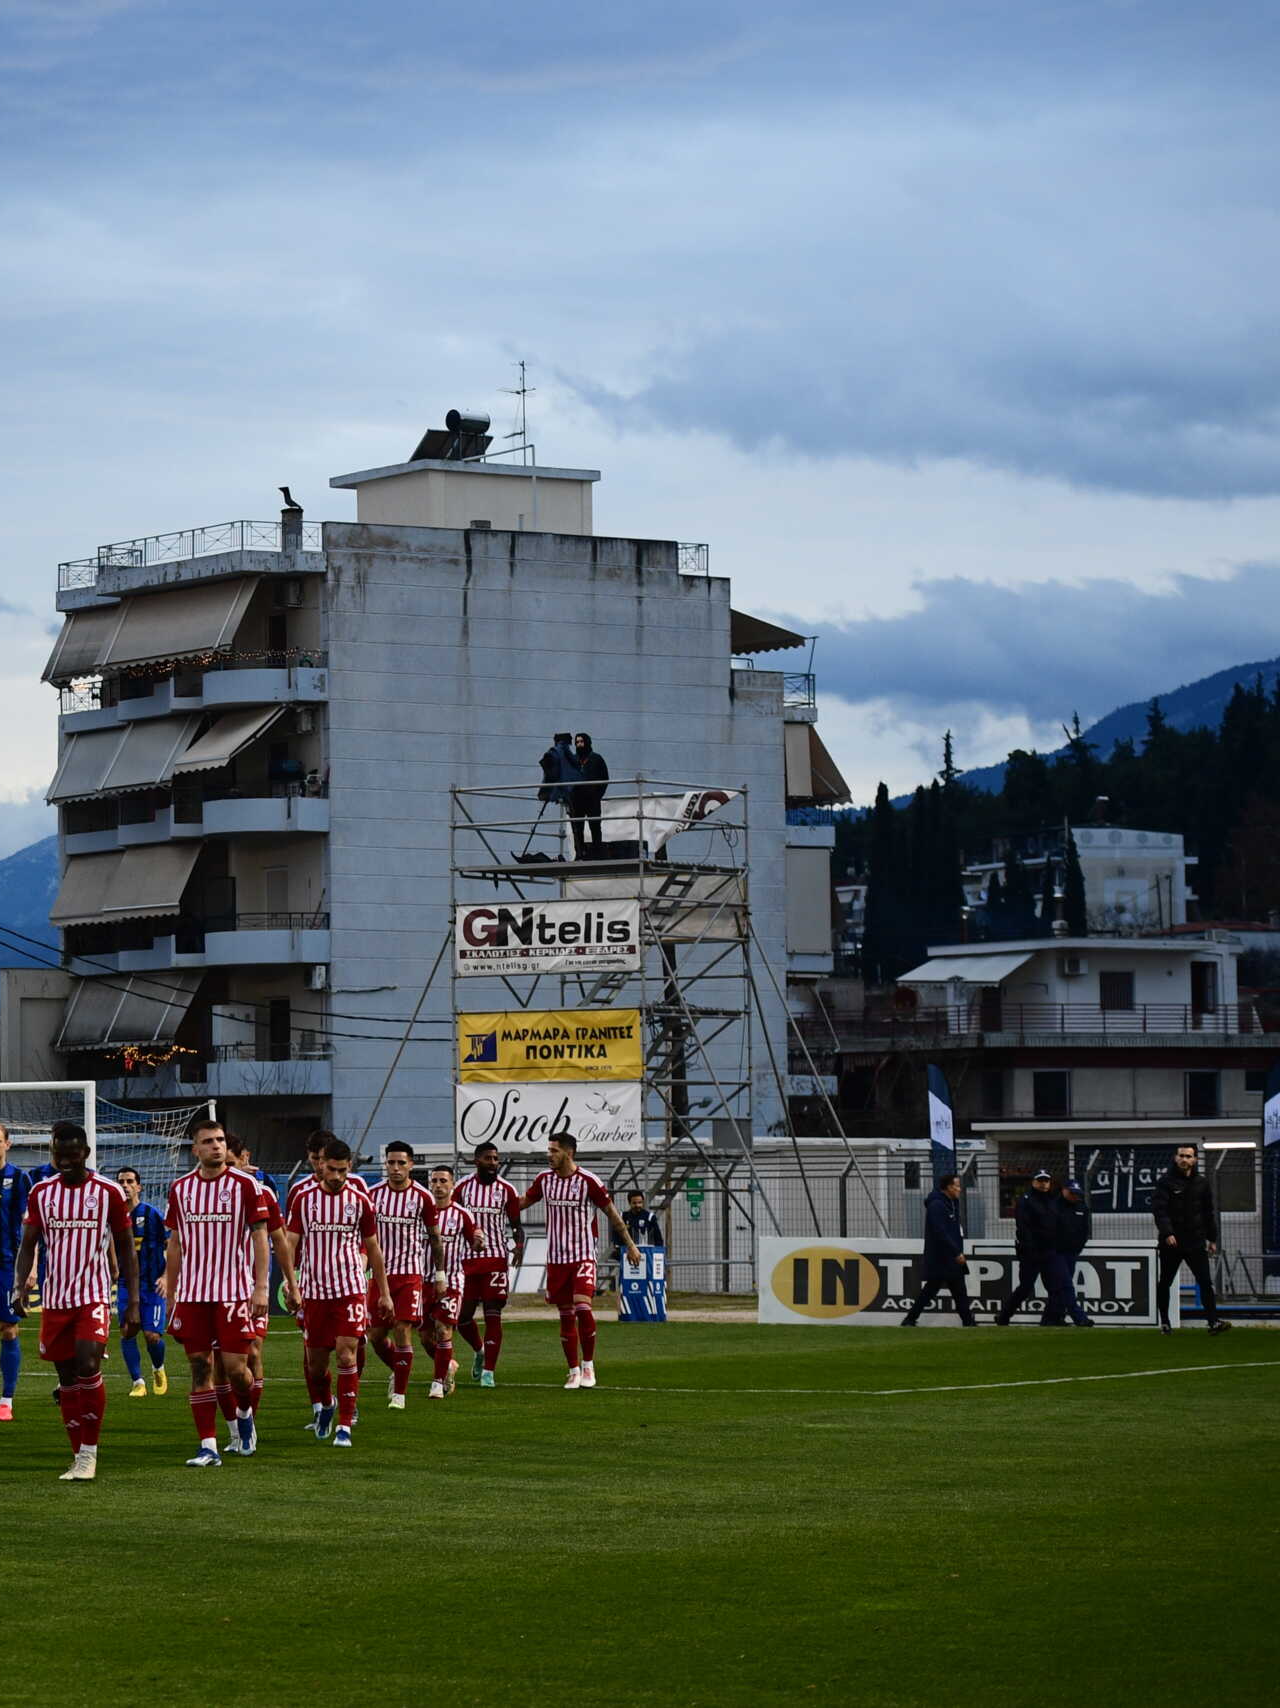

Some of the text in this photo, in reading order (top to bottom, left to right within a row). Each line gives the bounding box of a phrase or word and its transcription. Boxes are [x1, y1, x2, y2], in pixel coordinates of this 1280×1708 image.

[501, 1026, 633, 1041] ΜΑΡΜΑΡΑ ΓΡΑΝΙΤΕΣ
[526, 1044, 607, 1060] ΠΟΝΤΙΚΑ
[460, 1089, 571, 1146] Snob
[577, 1123, 638, 1142] Barber
[47, 1217, 99, 1229] Stoiximan
[184, 1212, 232, 1223] Stoiximan
[309, 1222, 355, 1233] Stoiximan
[576, 1262, 594, 1278] 22
[489, 1271, 507, 1287] 23
[91, 1303, 105, 1324] 4
[153, 1305, 161, 1320] 11
[223, 1302, 249, 1323] 74
[346, 1303, 364, 1323] 19
